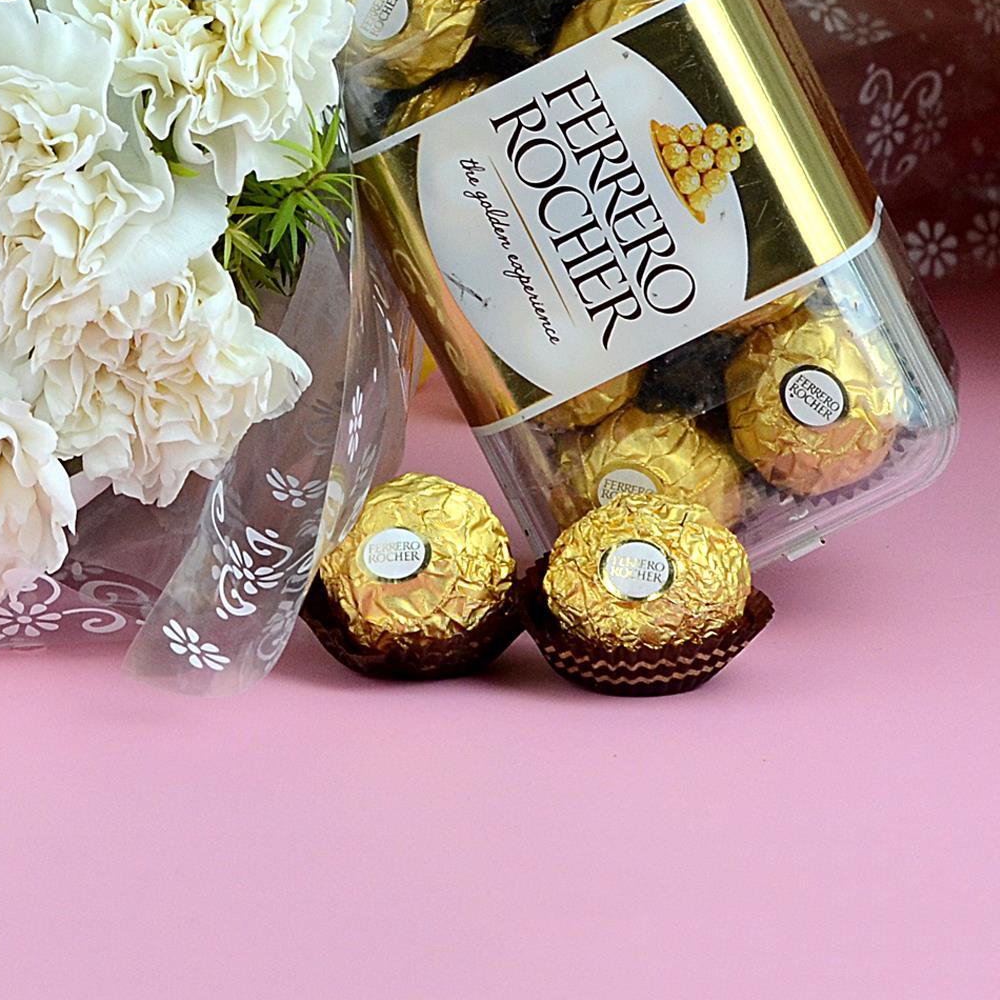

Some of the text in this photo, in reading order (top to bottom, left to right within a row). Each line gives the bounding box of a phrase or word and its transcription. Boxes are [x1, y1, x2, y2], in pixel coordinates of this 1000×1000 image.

[541, 70, 696, 314] FERRERO
[489, 96, 643, 350] ROCHER
[459, 158, 560, 345] the golden experience
[789, 382, 833, 421] ROCHER
[796, 374, 840, 412] FERRERO
[368, 541, 421, 554] FERRERO
[368, 551, 420, 564] ROCHER
